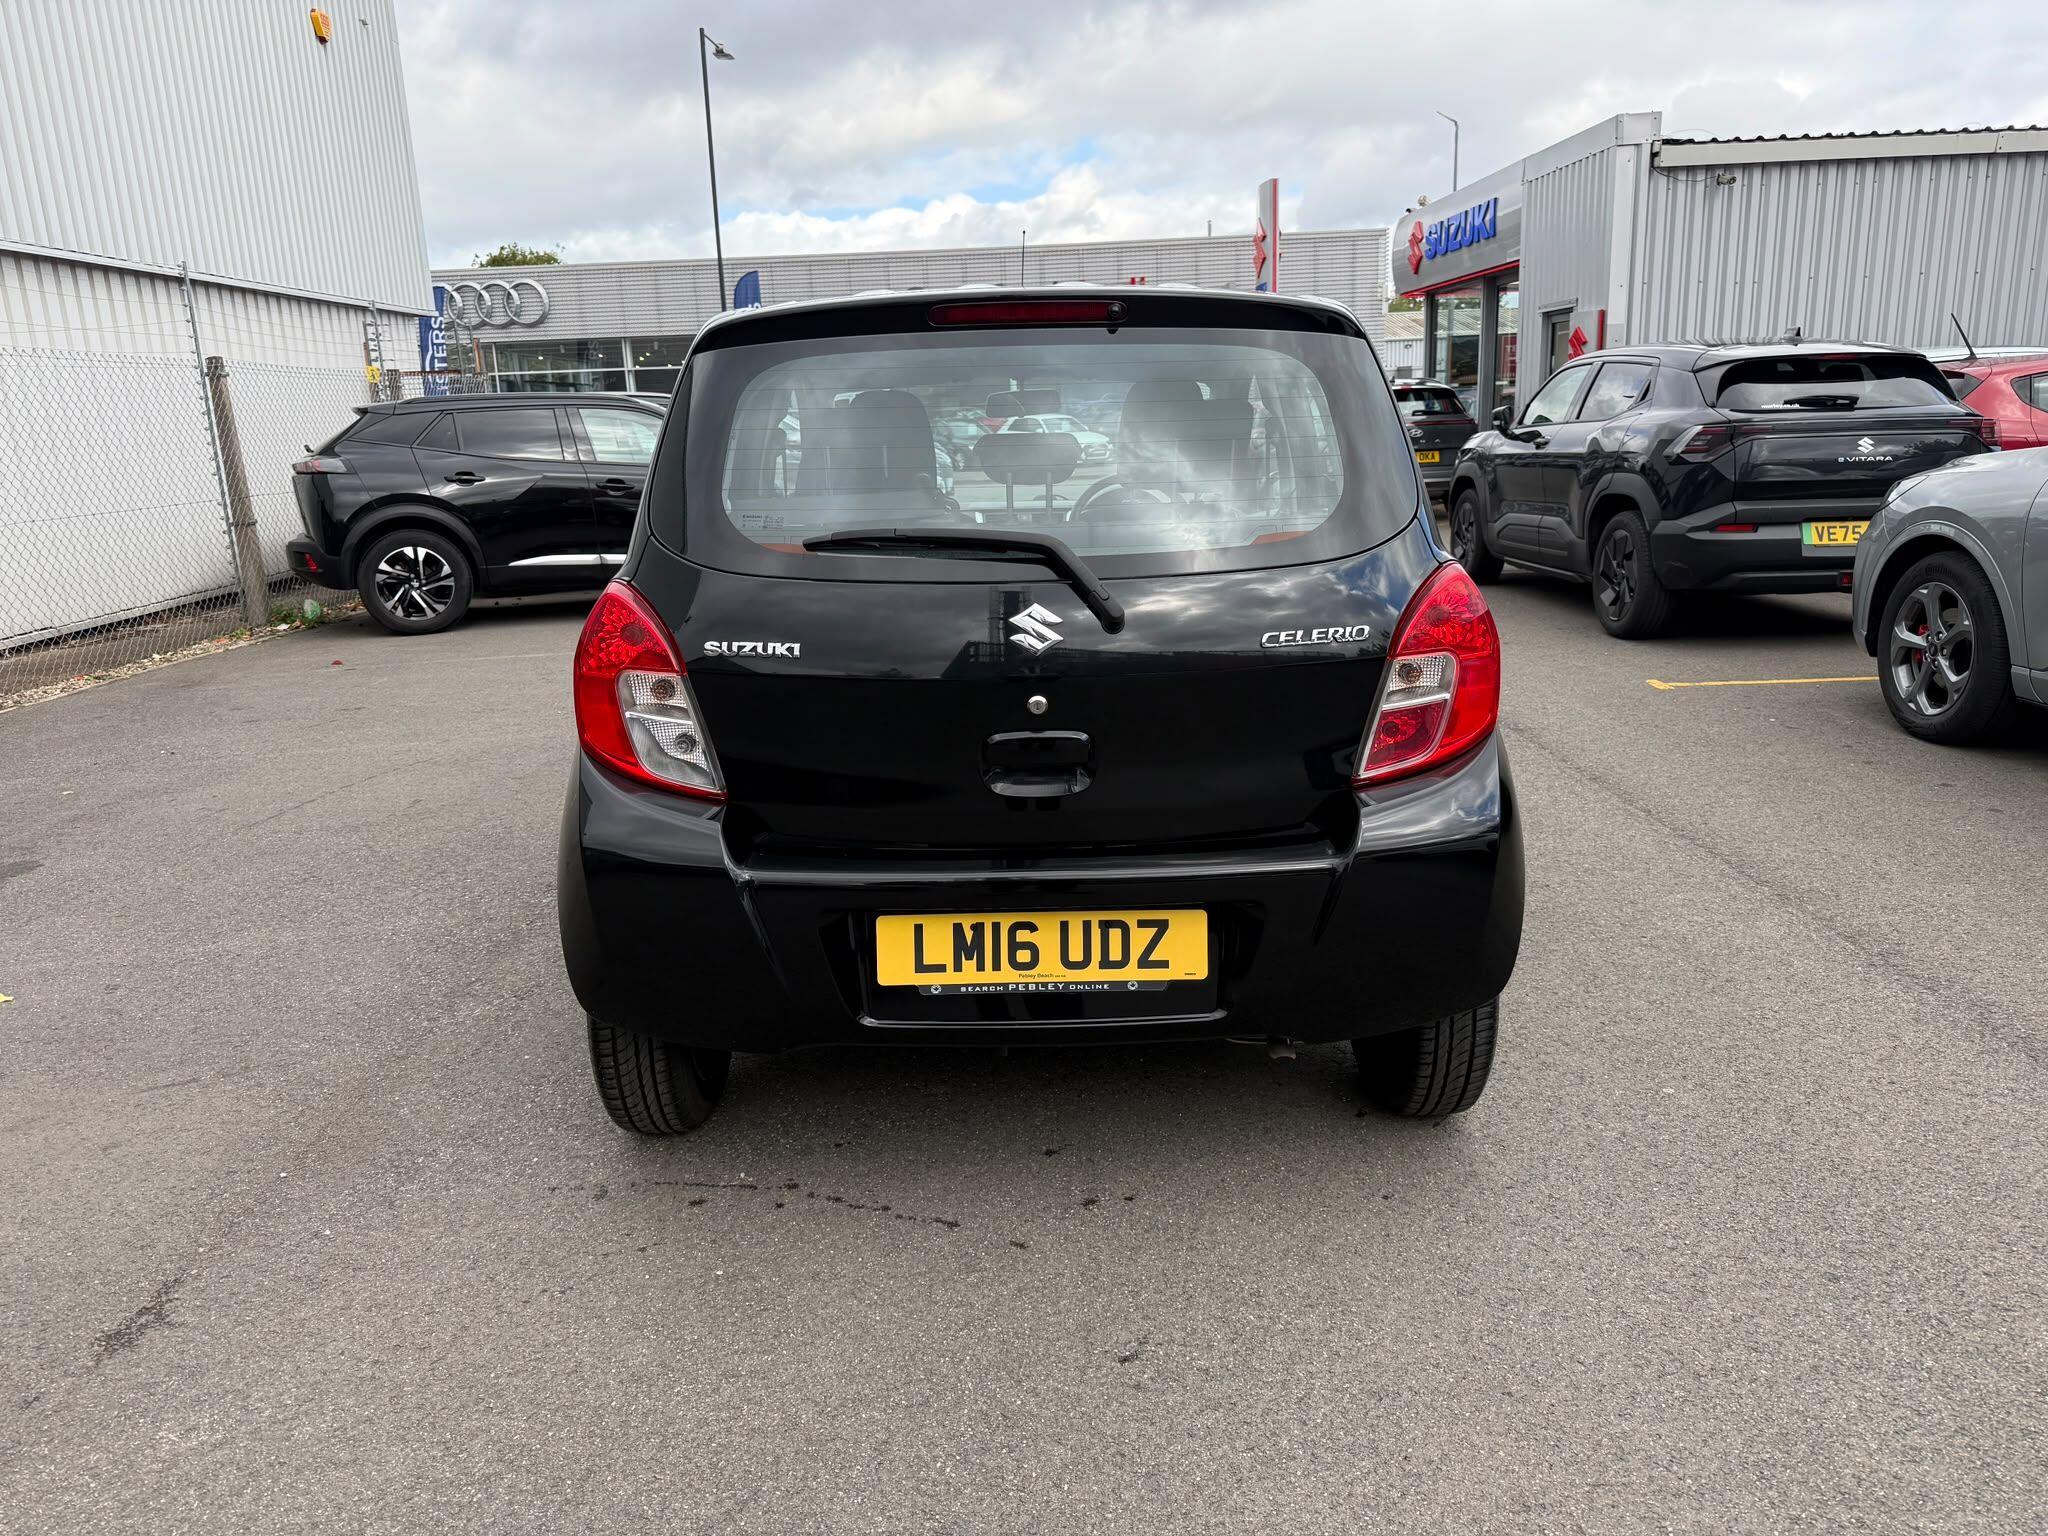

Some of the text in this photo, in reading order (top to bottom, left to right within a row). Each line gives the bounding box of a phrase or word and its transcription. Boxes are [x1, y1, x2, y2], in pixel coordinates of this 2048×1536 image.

[1425, 197, 1498, 261] SUZUKI
[1814, 525, 1861, 542] VE75
[1261, 625, 1370, 648] CELERIO
[703, 641, 801, 658] SUZUKI
[914, 919, 1170, 974] LM16 UDZ
[1008, 983, 1065, 991] PEBLEY
